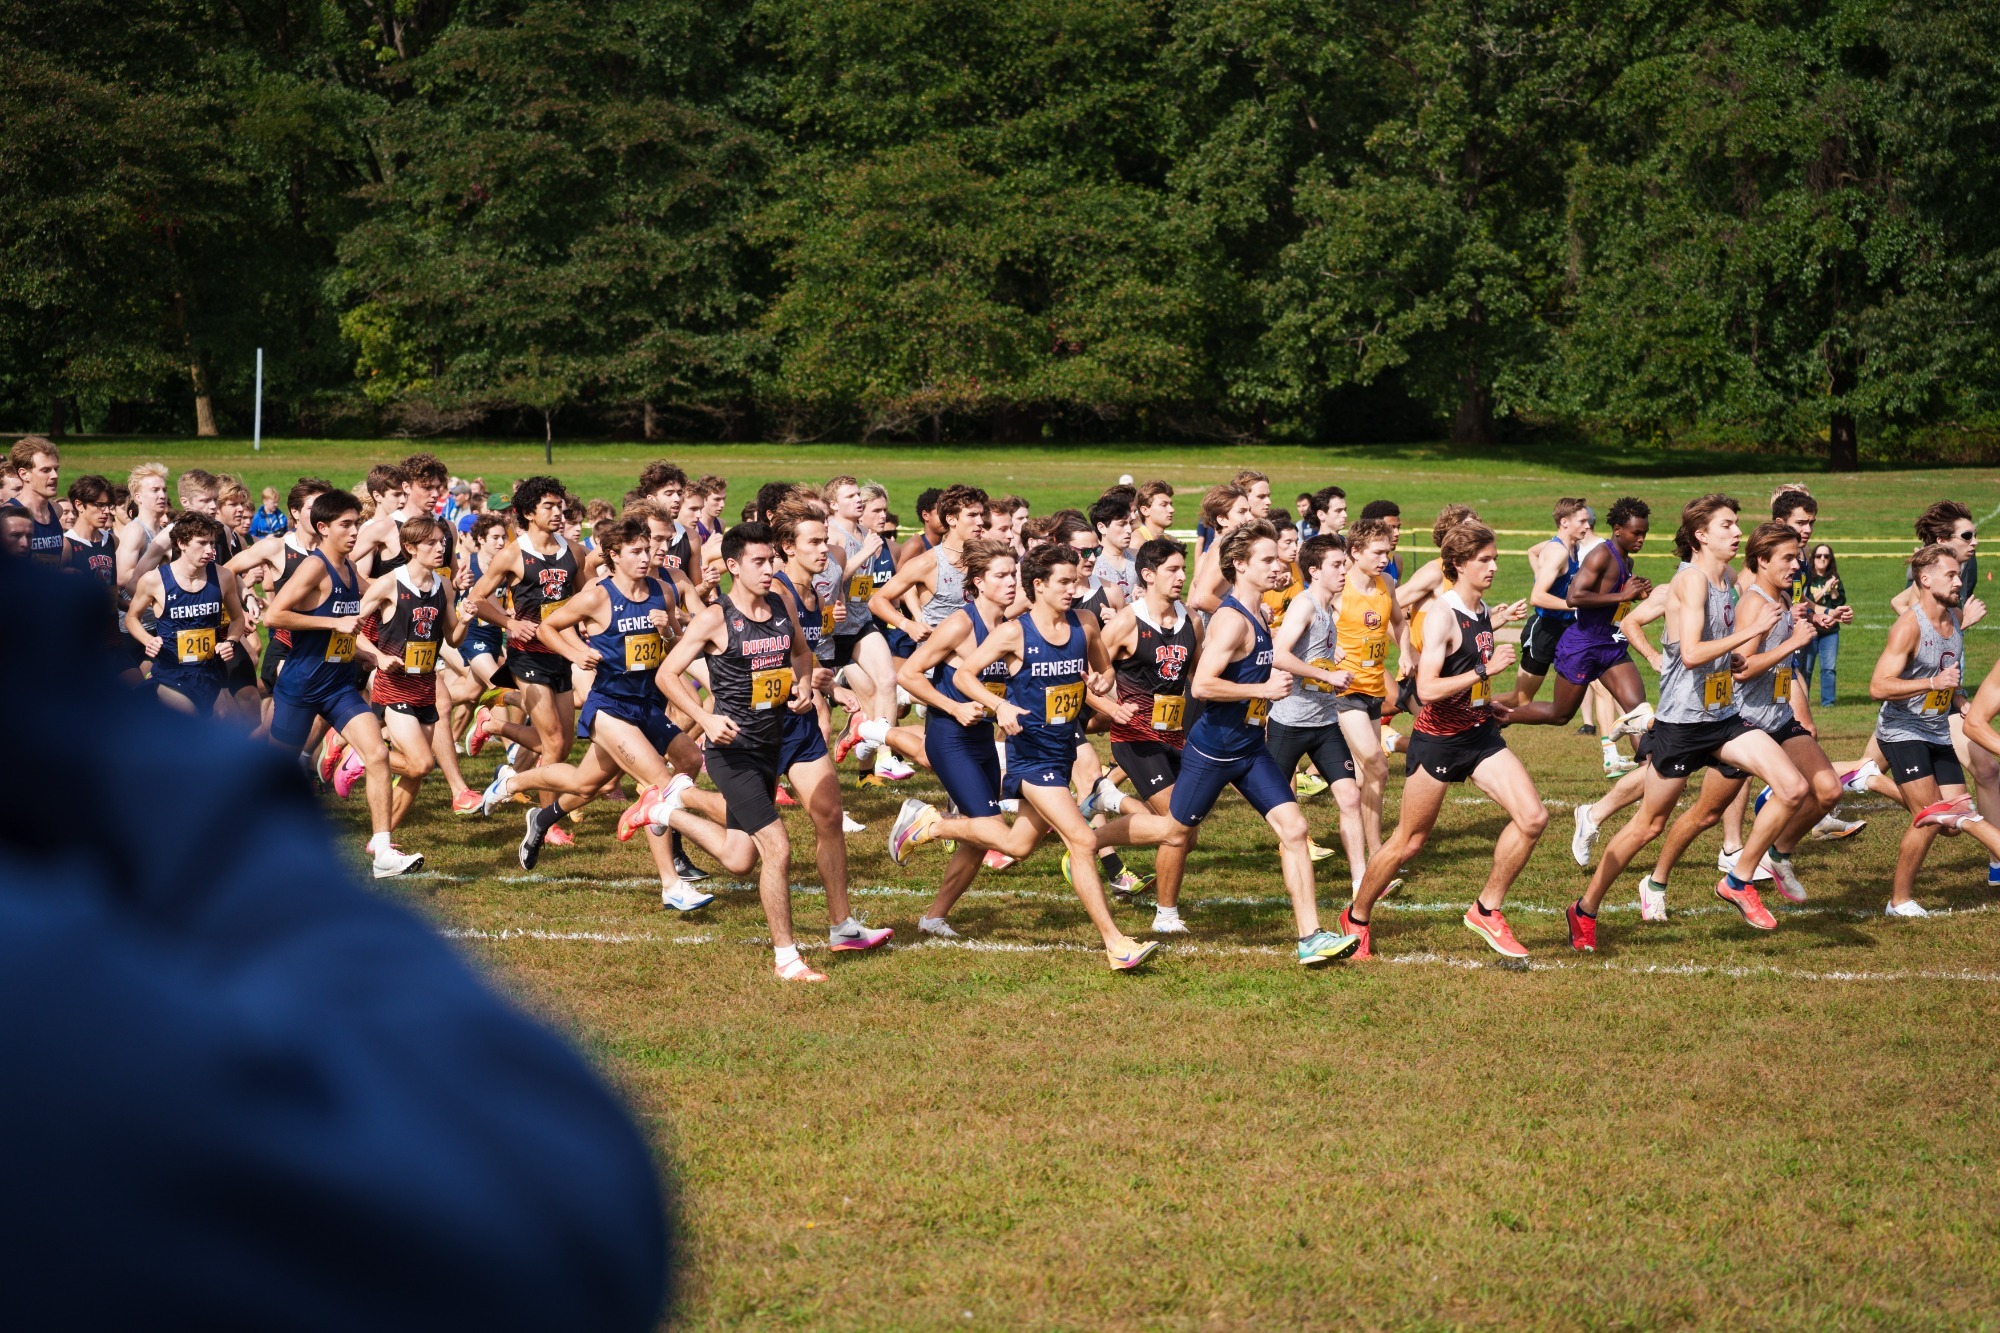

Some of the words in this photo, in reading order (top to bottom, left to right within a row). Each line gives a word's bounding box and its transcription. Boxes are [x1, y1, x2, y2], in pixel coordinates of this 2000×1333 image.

[31, 534, 63, 550] GENESEO
[88, 555, 113, 570] RIT
[663, 555, 682, 569] IT
[539, 569, 567, 583] RIT
[170, 602, 220, 620] GENESEO
[332, 601, 360, 614] GENESEO
[413, 607, 438, 621] RIT
[618, 615, 654, 632] GENES
[186, 636, 211, 654] 216
[334, 638, 353, 655] 230
[742, 635, 790, 656] BUFFALO
[1475, 631, 1493, 652] RIT
[414, 649, 432, 666] 172
[634, 643, 657, 662] 232
[1156, 645, 1188, 663] RIT
[1255, 650, 1274, 666] GENE
[1369, 642, 1386, 659] 133
[982, 661, 1009, 676] GENES
[1031, 658, 1084, 677] GENESEO
[765, 679, 782, 699] 39
[1715, 681, 1727, 700] 64
[1054, 692, 1079, 714] 234
[1935, 690, 1950, 707] 53
[1161, 703, 1179, 722] 175
